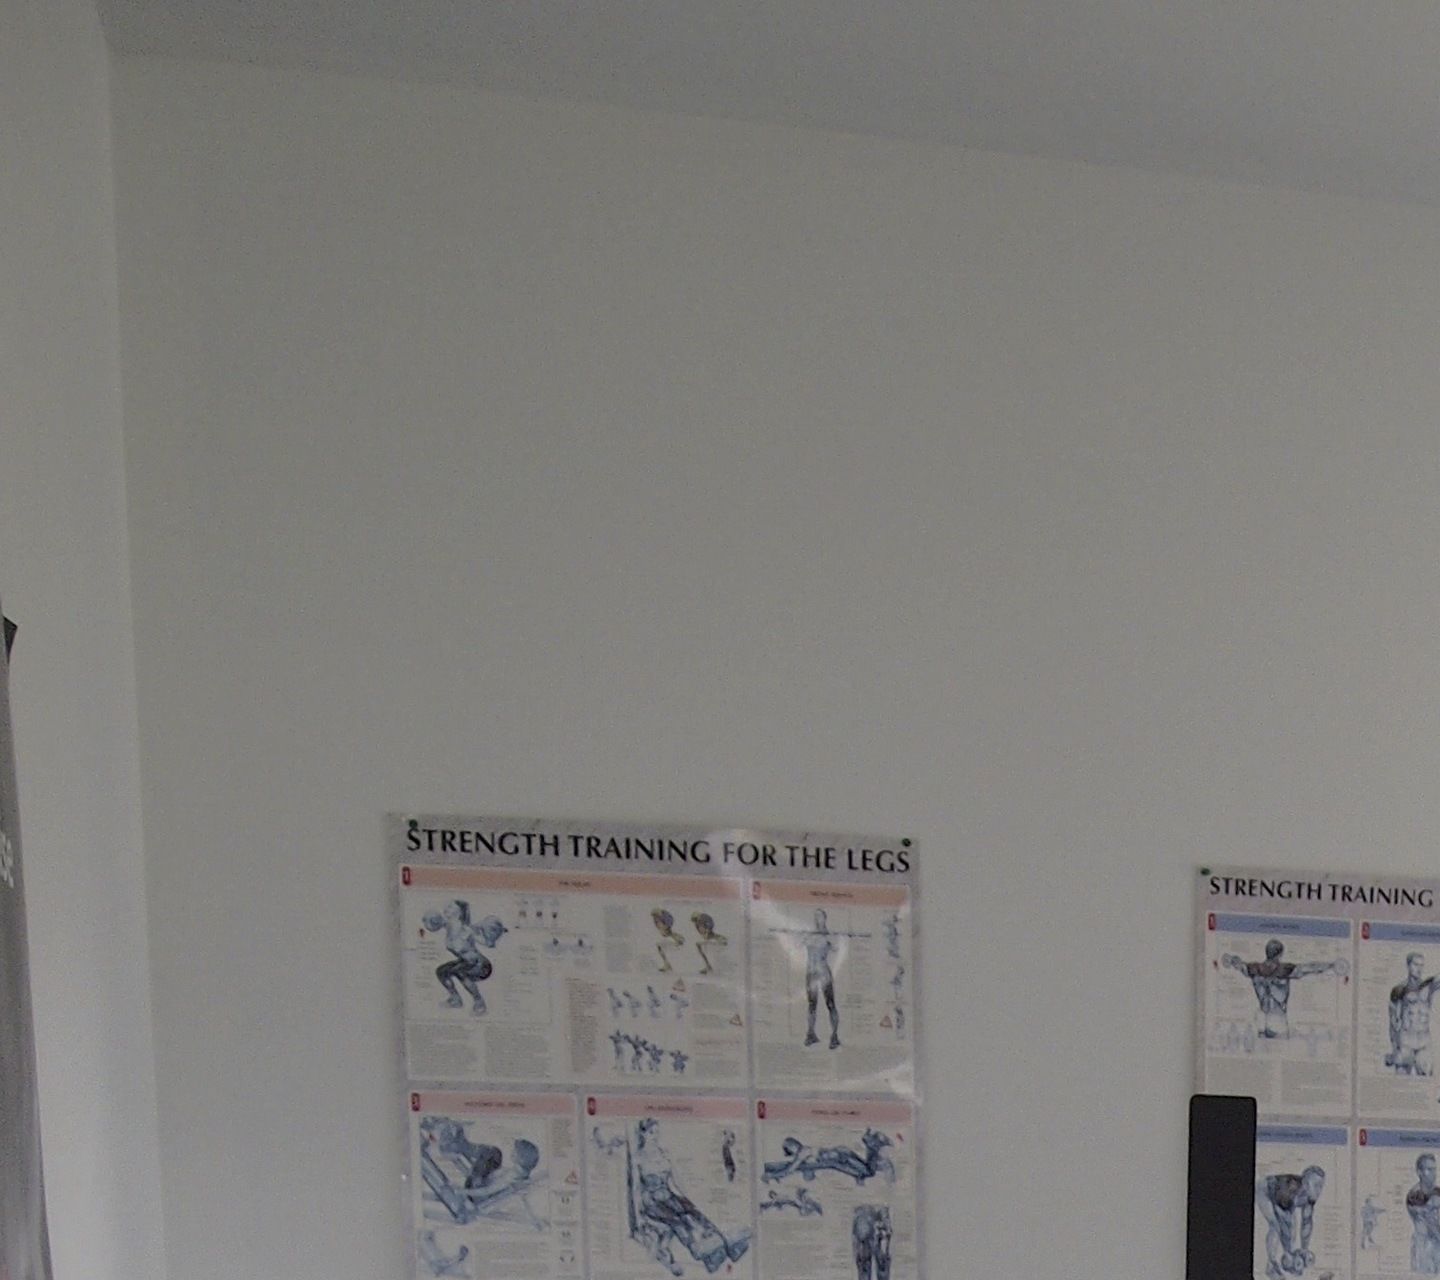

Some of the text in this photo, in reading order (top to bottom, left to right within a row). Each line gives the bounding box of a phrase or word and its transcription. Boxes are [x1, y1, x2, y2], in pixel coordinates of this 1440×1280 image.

[407, 827, 911, 873] STRENGTH TRAINING FOR THE LEGS
[1209, 876, 1322, 901] STRENGTH
[1328, 884, 1434, 908] TRAINING
